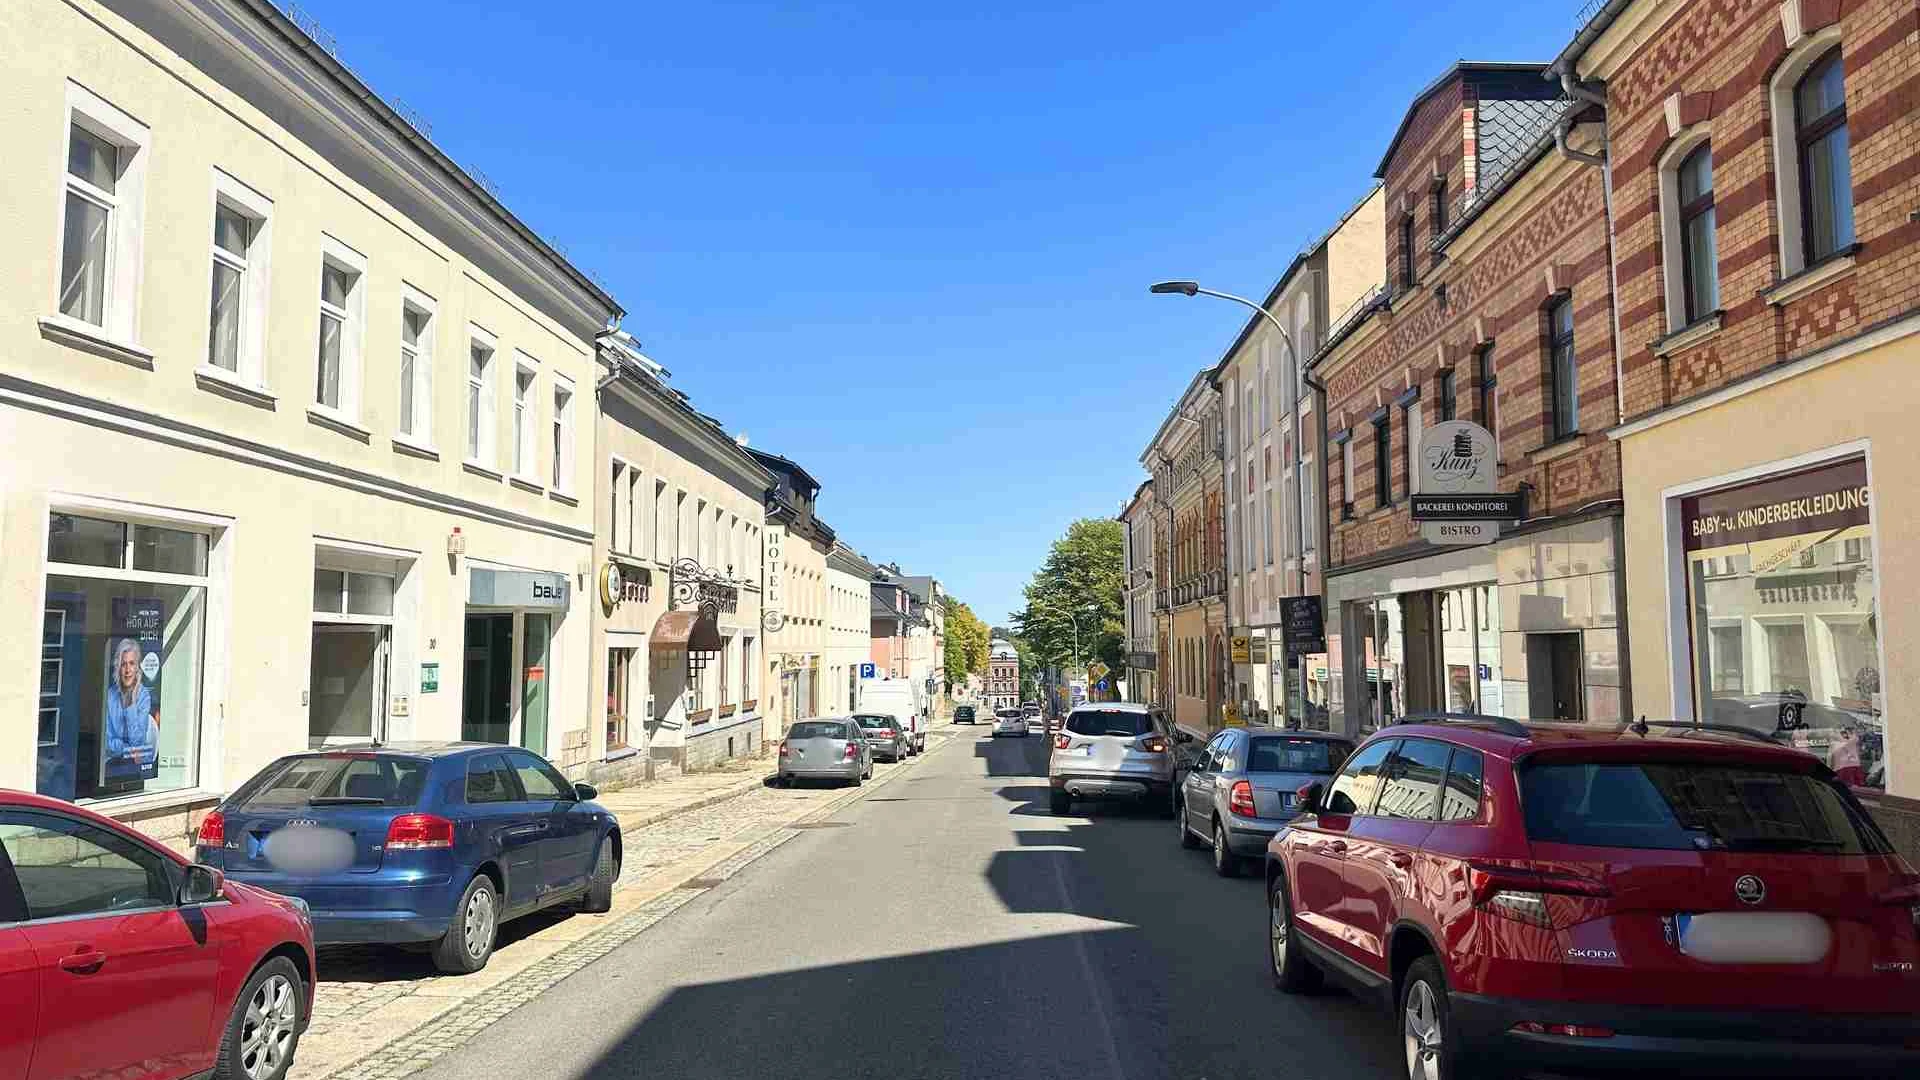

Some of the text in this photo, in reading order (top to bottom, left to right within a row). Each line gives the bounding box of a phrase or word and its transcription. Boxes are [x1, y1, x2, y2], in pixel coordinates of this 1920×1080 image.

[1432, 448, 1482, 479] Kunz
[1456, 502, 1508, 512] KONDITOREI
[1738, 487, 1870, 529] KINDERBEKLEIDUNG
[1440, 525, 1481, 536] BISTRO
[768, 532, 779, 601] HOTEL
[143, 617, 160, 629] AUF
[140, 630, 159, 641] DICH
